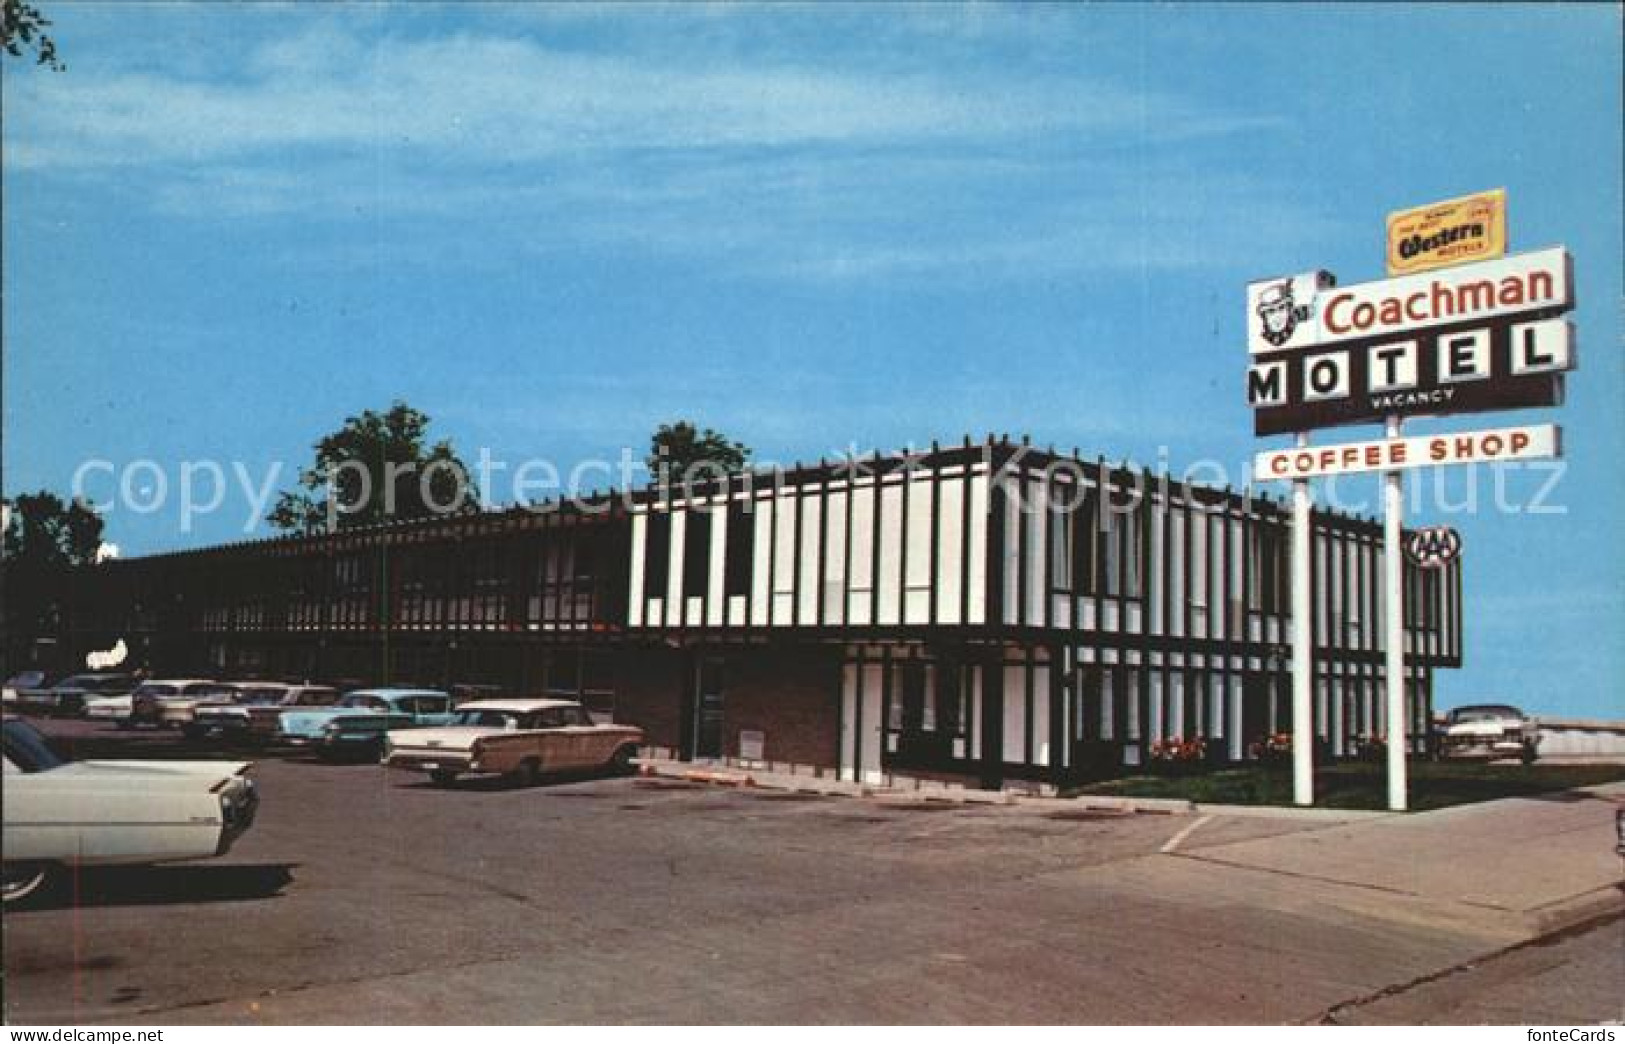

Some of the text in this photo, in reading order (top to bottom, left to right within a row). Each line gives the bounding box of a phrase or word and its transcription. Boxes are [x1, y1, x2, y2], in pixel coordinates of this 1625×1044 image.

[1399, 222, 1483, 259] Western
[1323, 270, 1554, 334] Coachman
[1249, 327, 1554, 404] MOTEL
[1371, 387, 1454, 409] VACANCY
[1271, 432, 1530, 474] COFFEE SHOP
[1410, 529, 1458, 561] AAA
